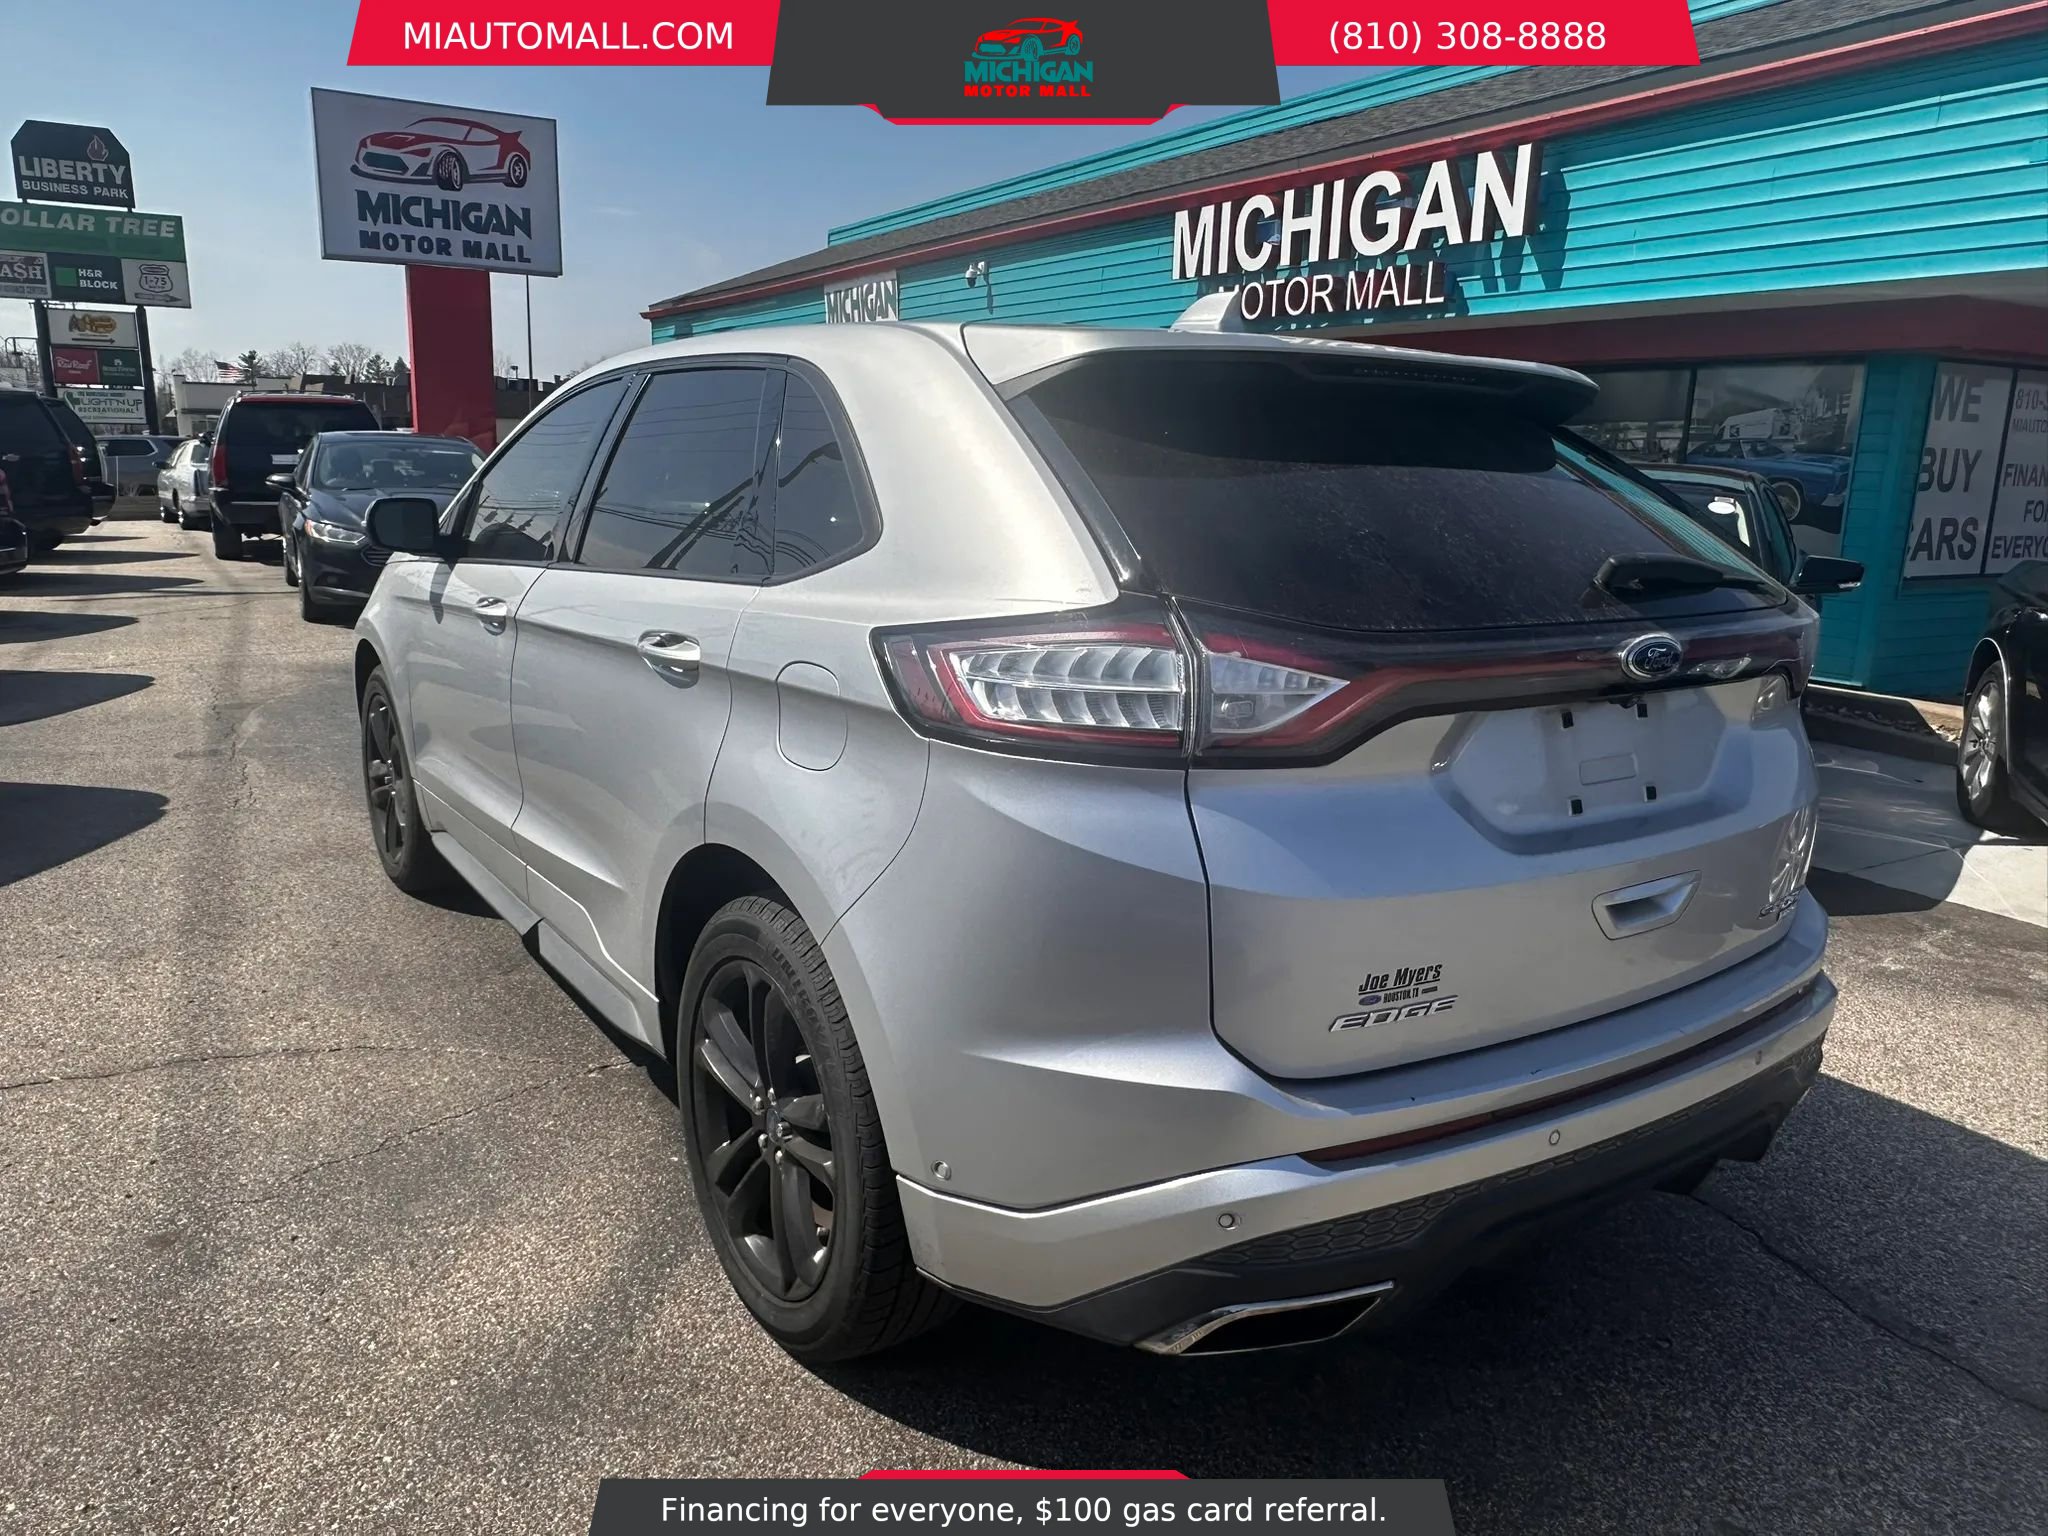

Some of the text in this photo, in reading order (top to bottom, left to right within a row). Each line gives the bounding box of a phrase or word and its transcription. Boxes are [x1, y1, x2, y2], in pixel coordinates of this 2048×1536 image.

[18, 156, 126, 185] LIBERTY
[22, 180, 129, 198] BUSINESS PARK
[105, 216, 176, 238] TREE
[354, 189, 532, 240] MICHIGAN
[1172, 143, 1533, 280] MICHIGAN
[359, 230, 531, 264] MOTOR MALL
[78, 268, 103, 278] H&R
[79, 279, 118, 290] BLOCK
[1219, 260, 1445, 320] OTOR MALL
[825, 279, 898, 323] MICHIGAN
[1934, 375, 1986, 423] WE
[1918, 447, 1982, 492] BUY
[1908, 517, 1979, 561] ARS
[1645, 647, 1674, 669] Ford
[1358, 964, 1443, 992] Joe Myers
[1329, 995, 1459, 1032] EDGE
